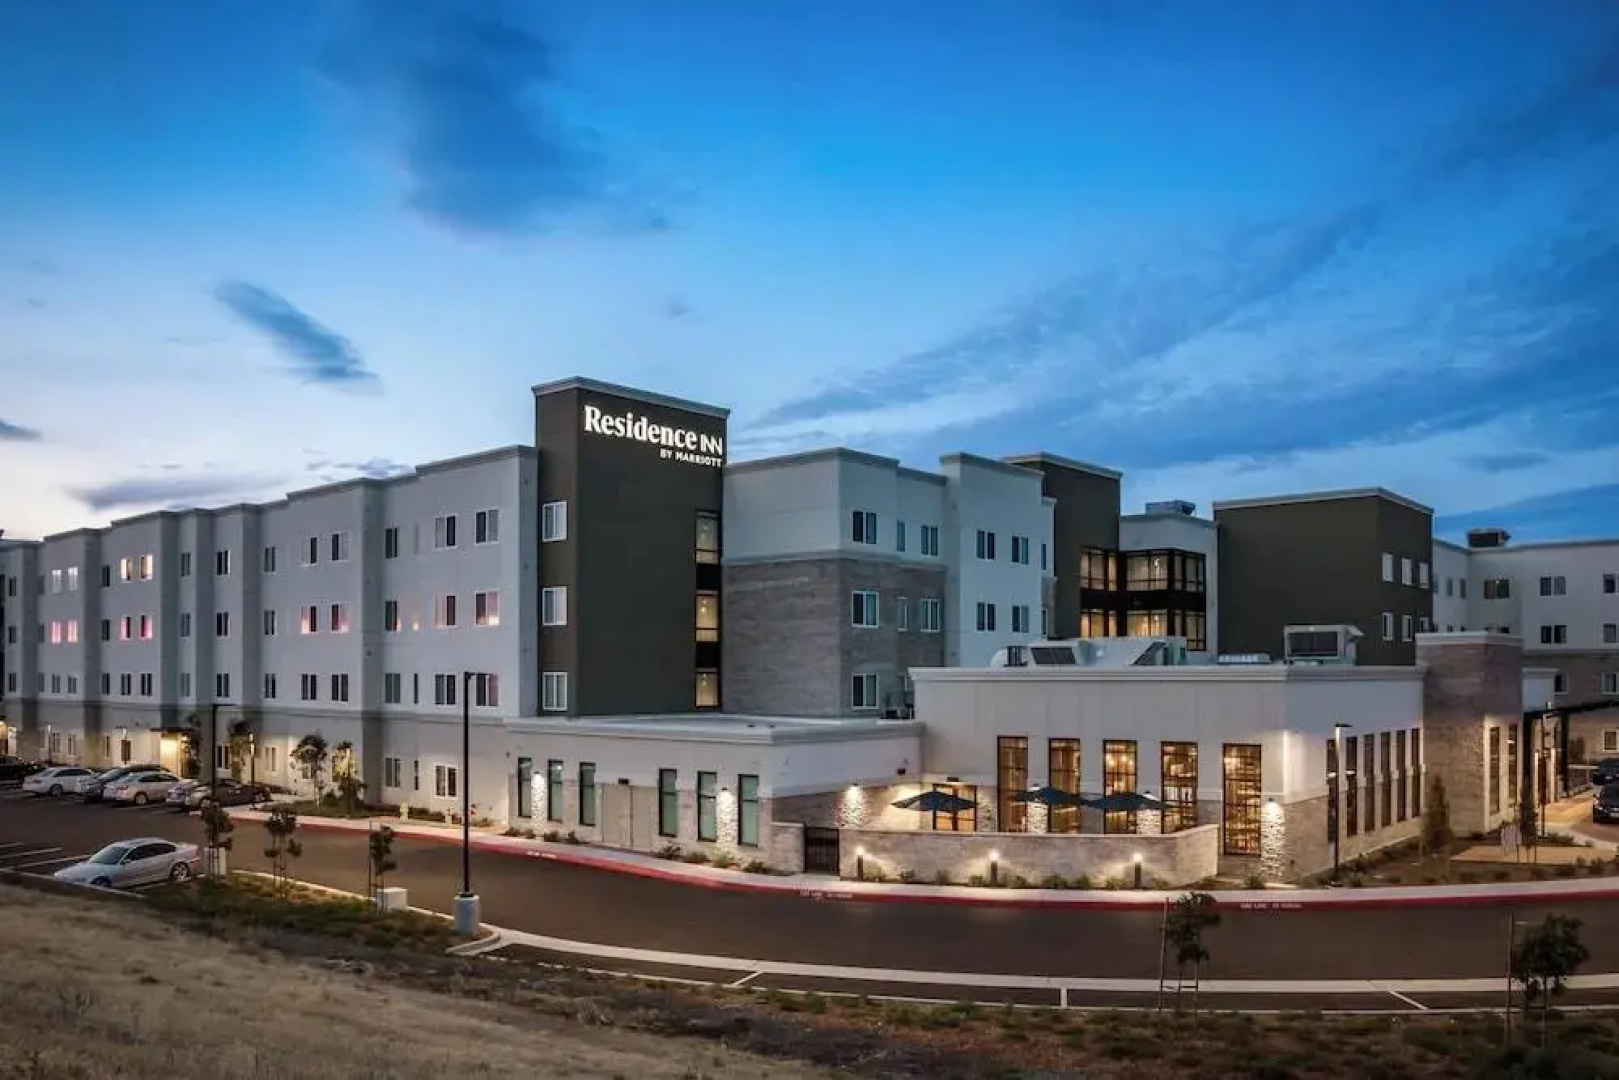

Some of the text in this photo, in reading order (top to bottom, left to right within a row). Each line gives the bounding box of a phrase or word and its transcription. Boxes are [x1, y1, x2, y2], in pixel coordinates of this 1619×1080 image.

[584, 405, 698, 450] Residence
[660, 448, 722, 467] BY MARRIOTT
